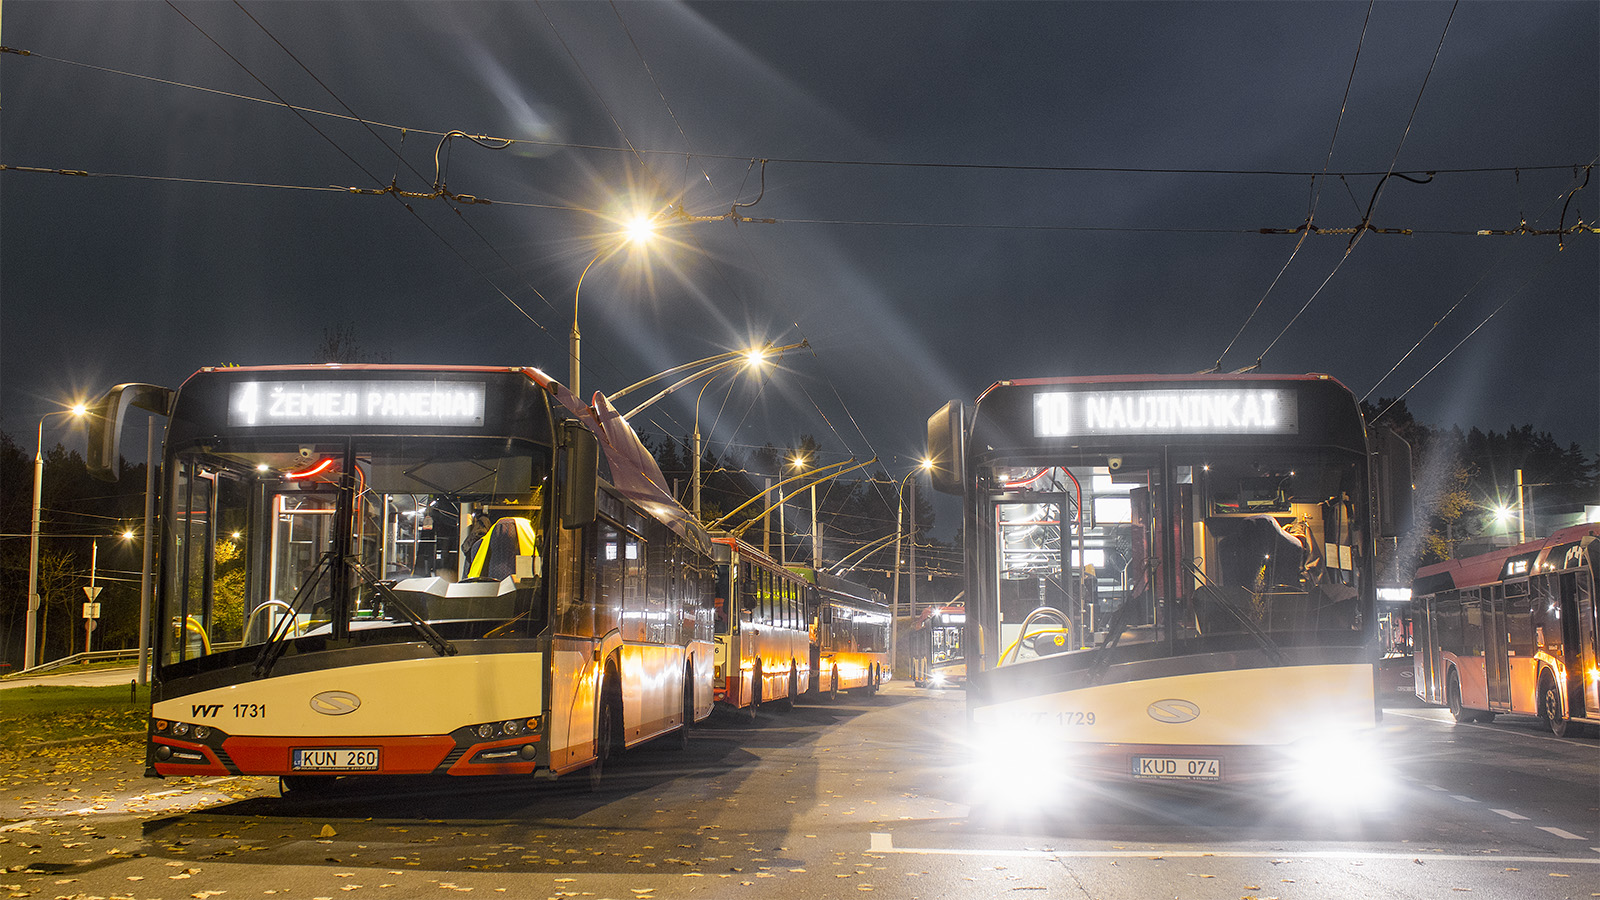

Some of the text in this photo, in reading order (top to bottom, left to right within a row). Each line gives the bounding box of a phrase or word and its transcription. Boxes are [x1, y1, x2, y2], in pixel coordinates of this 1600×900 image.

[238, 382, 476, 424] 4 ŽEMIEJI PANERIAI
[1038, 392, 1276, 435] 10 NAUJININKAI
[232, 704, 266, 718] 1731
[1056, 711, 1096, 726] 1729
[303, 751, 337, 766] KUN
[347, 751, 375, 766] 260
[1142, 759, 1177, 774] KUD
[1188, 760, 1217, 775] 074
